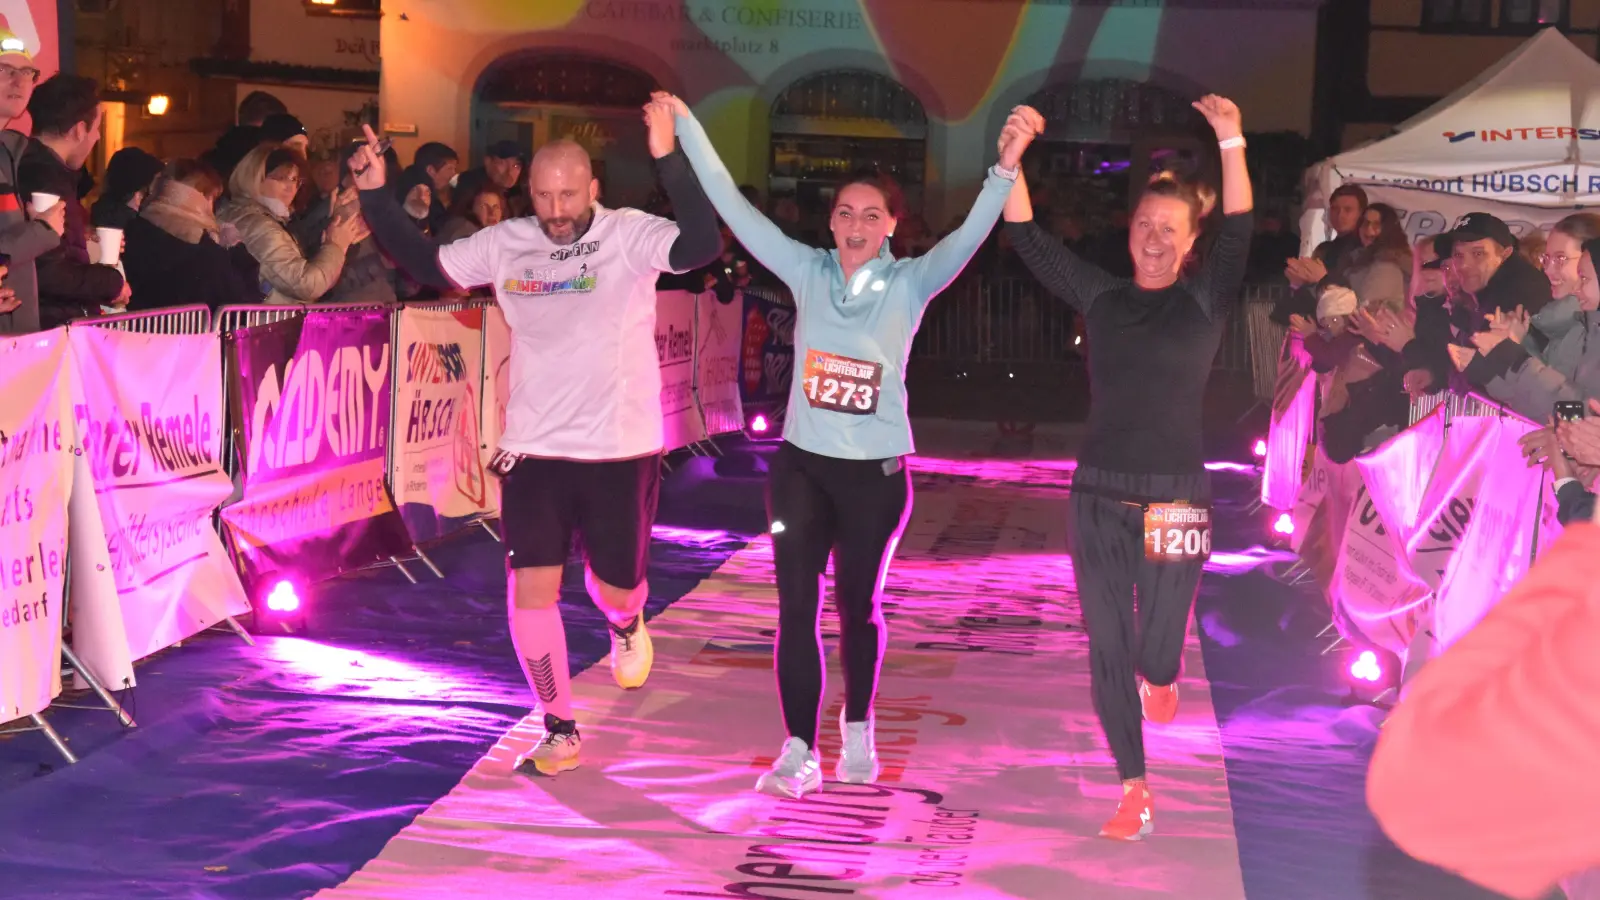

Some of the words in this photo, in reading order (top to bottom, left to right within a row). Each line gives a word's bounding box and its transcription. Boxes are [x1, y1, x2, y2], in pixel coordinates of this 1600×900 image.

[697, 10, 714, 24] &
[722, 6, 861, 30] CONFISERIE
[670, 36, 763, 54] marktplatz
[769, 38, 780, 54] 8
[1472, 170, 1578, 193] HÜBSCH
[550, 241, 600, 260] STFAN
[823, 361, 875, 380] LICHTERLAUF
[808, 375, 873, 410] 1273
[141, 394, 213, 473] Remele
[339, 477, 385, 512] Lange
[1164, 513, 1209, 523] LICHTERLAU
[1150, 528, 1210, 555] 1206
